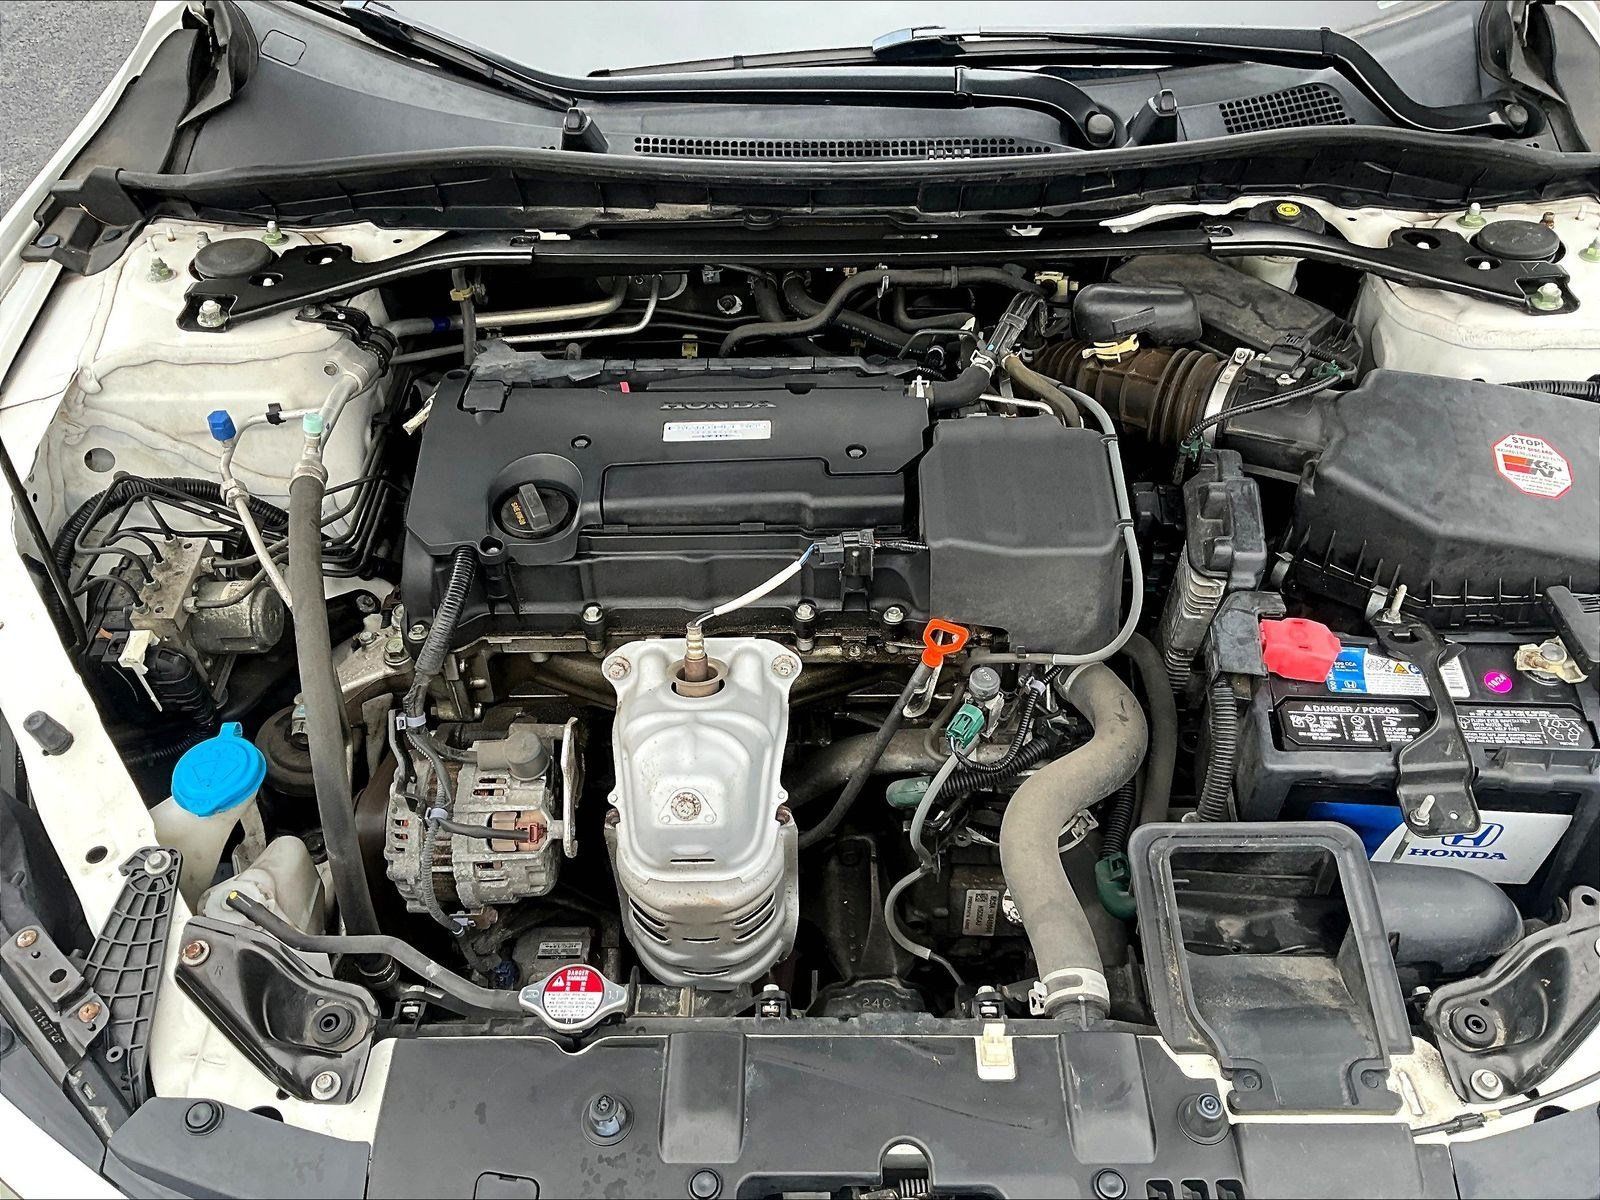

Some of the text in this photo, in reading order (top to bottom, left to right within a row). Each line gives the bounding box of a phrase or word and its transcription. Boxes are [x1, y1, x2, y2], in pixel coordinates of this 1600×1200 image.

[660, 401, 777, 410] HONDA
[1511, 436, 1544, 448] STOP!
[1312, 704, 1354, 713] DANGER
[1362, 706, 1400, 714] POISON
[1407, 848, 1508, 861] HONDA
[862, 998, 891, 1009] 24C
